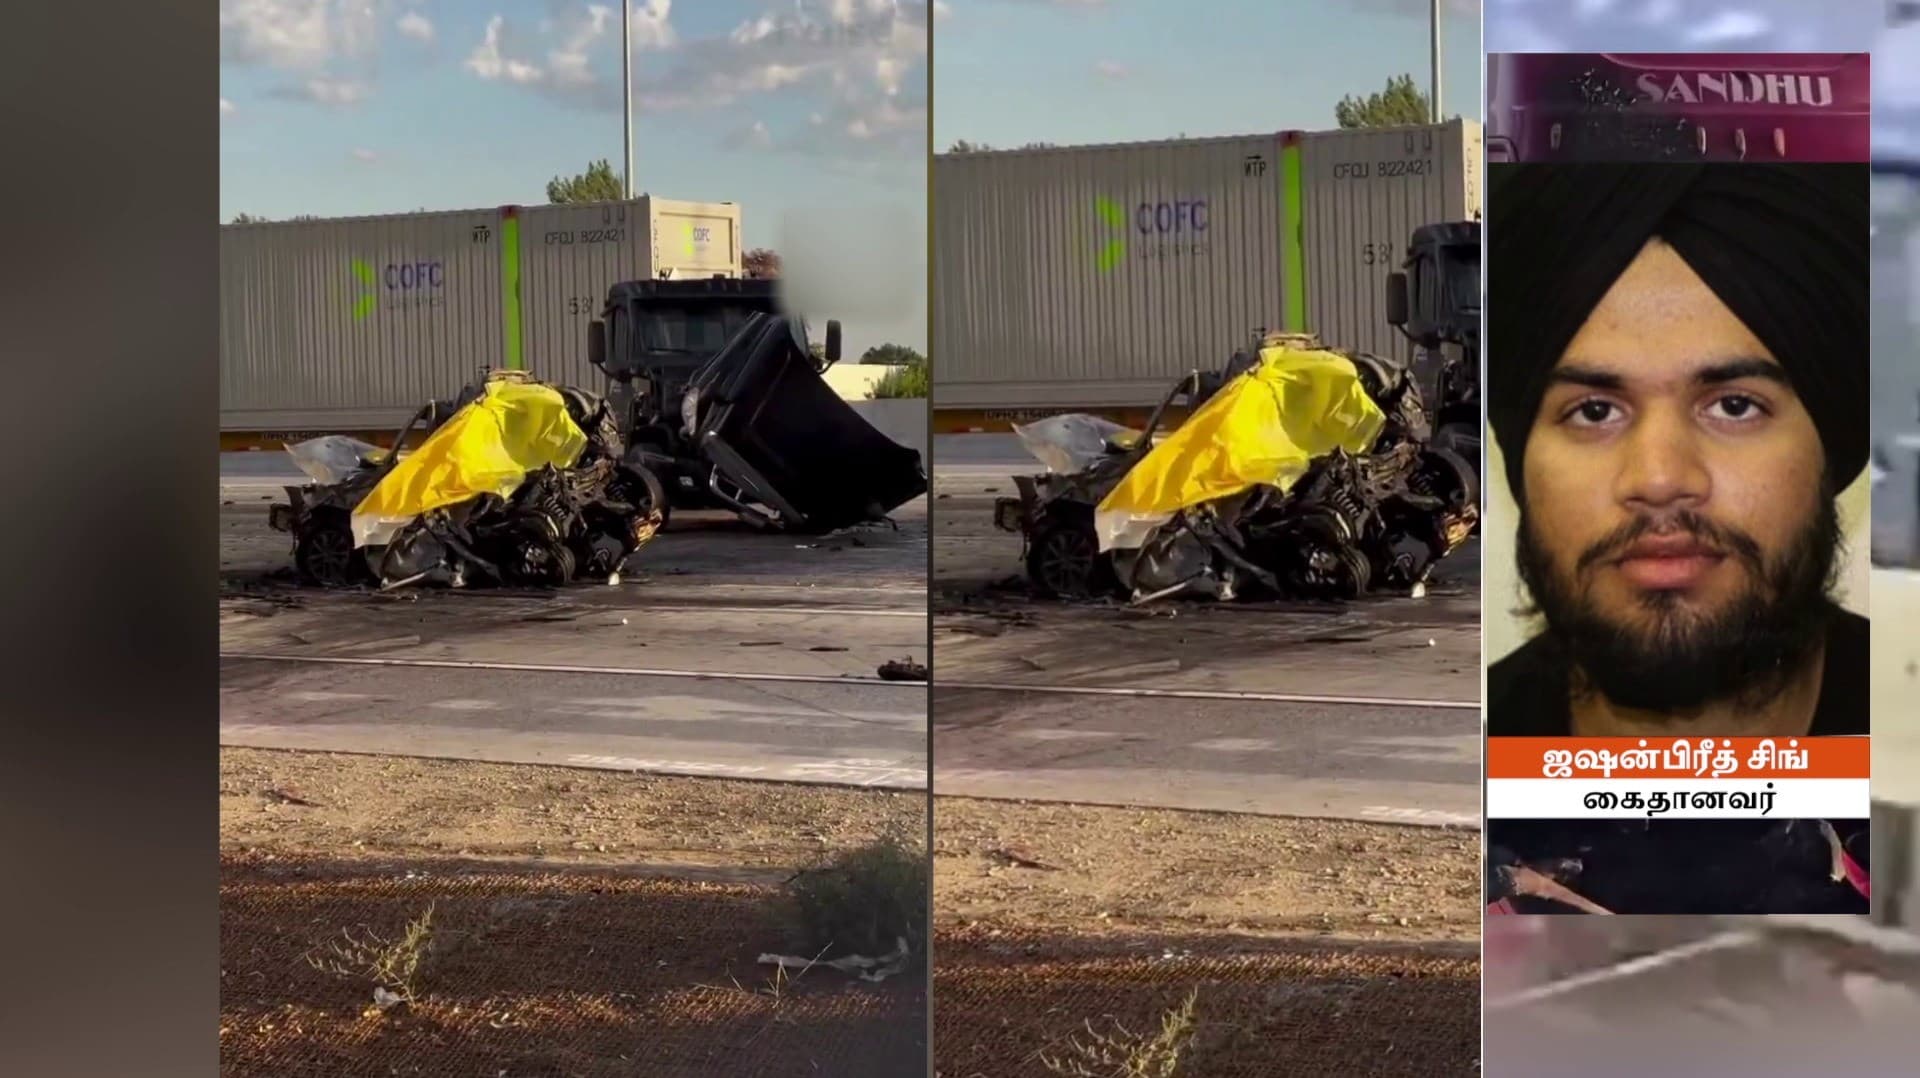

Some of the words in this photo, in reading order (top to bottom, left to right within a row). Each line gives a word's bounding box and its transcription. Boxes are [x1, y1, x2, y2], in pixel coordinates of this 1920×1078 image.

[1636, 72, 1833, 106] SANDHU
[1378, 159, 1433, 177] 822421
[1137, 201, 1208, 234] COFC
[580, 228, 625, 243] 822421
[384, 262, 442, 291] COFC
